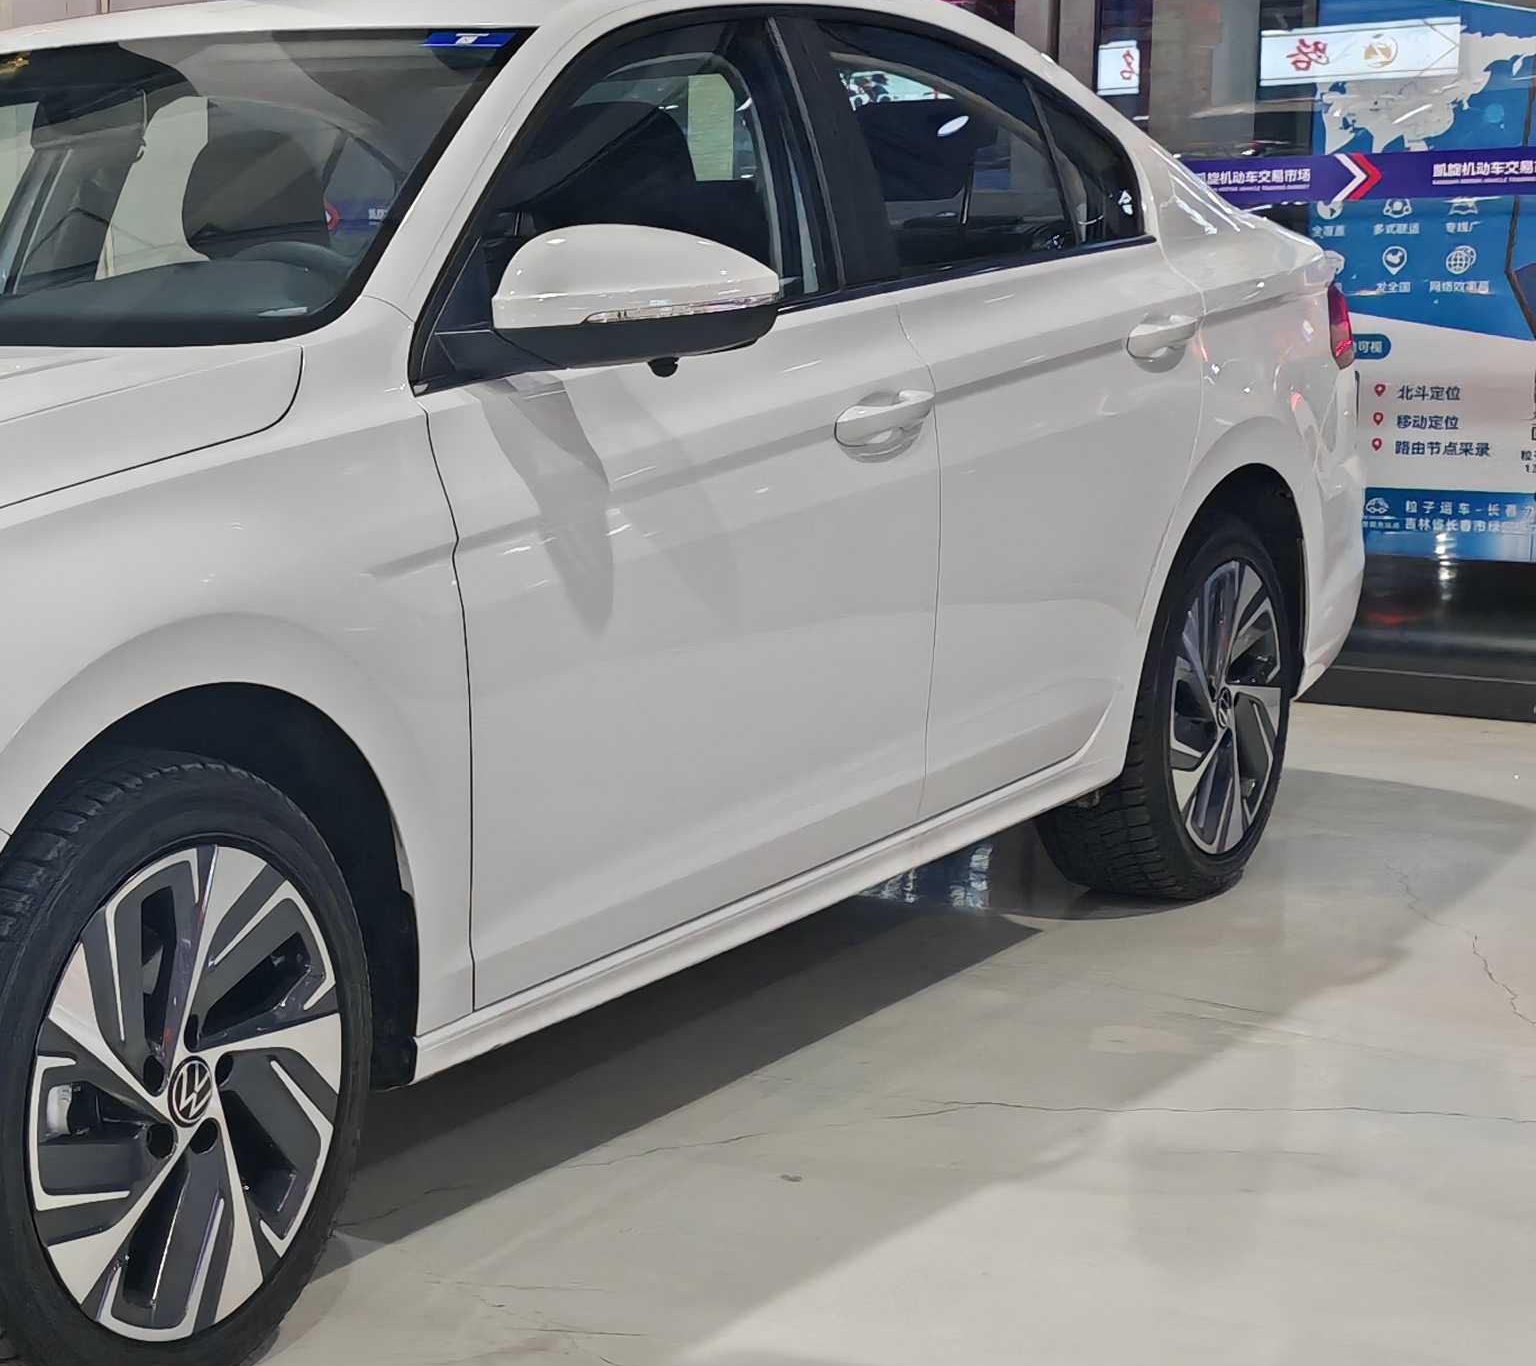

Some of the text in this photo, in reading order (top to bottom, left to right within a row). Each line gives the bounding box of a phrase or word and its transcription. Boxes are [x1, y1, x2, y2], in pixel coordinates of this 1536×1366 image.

[1432, 160, 1536, 178] 凯旋机动车交易
[1398, 386, 1461, 401] 北斗定位
[1396, 414, 1459, 430] 移动定位
